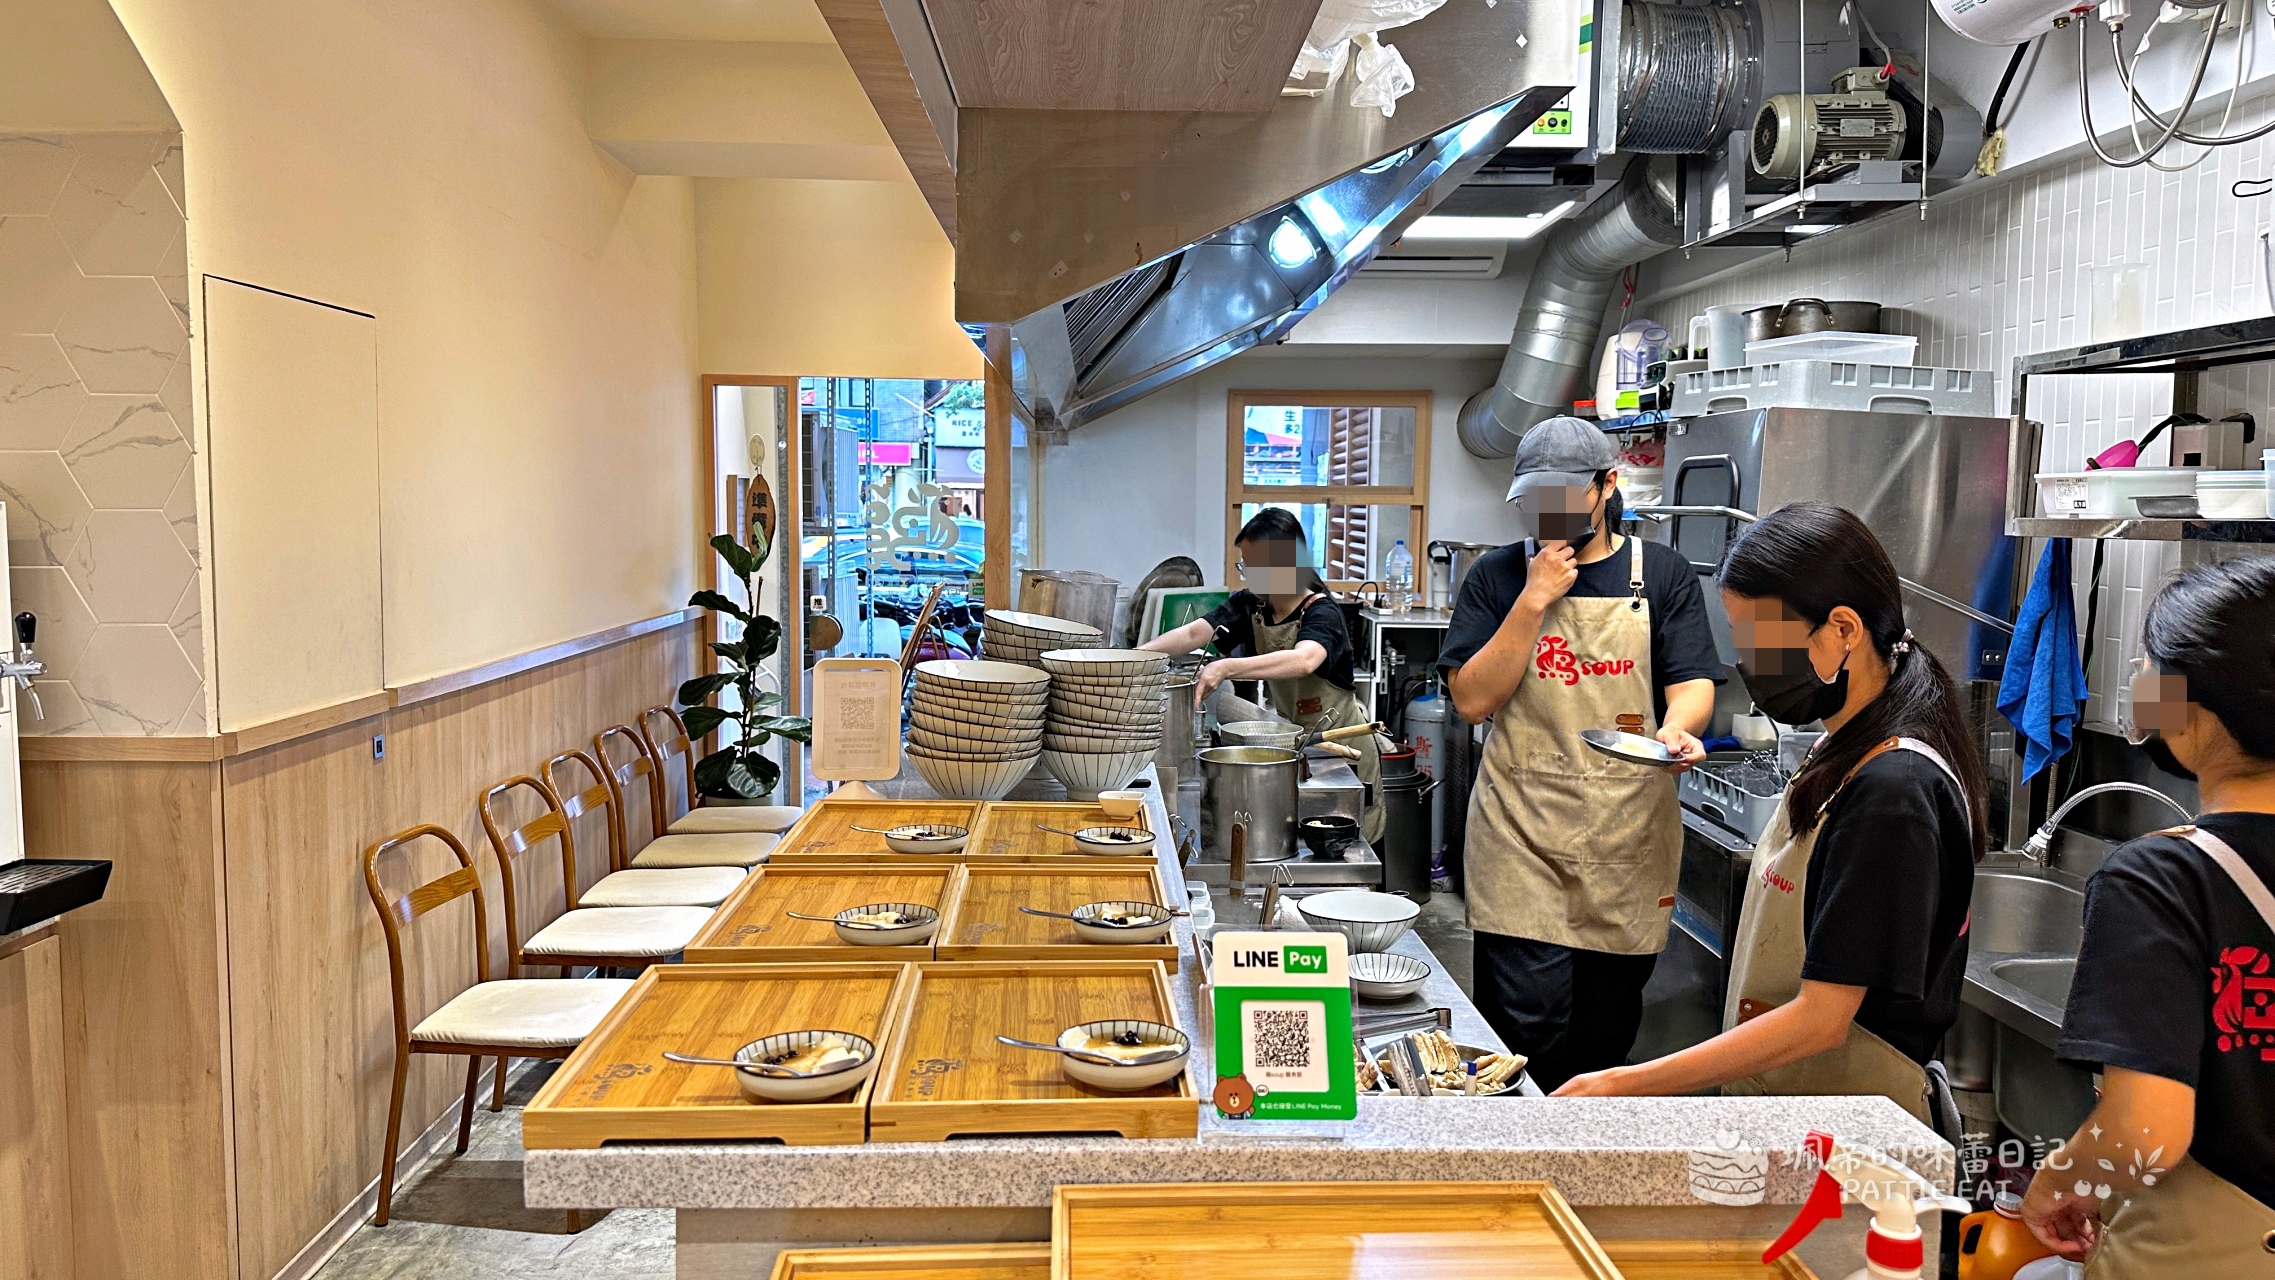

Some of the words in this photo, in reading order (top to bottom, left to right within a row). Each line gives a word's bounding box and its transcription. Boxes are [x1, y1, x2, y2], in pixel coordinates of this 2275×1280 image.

[952, 419, 973, 427] RICE
[1285, 410, 1296, 422] 生
[1581, 659, 1635, 676] SOUP
[1233, 950, 1279, 968] LINE
[1289, 951, 1323, 970] Pay
